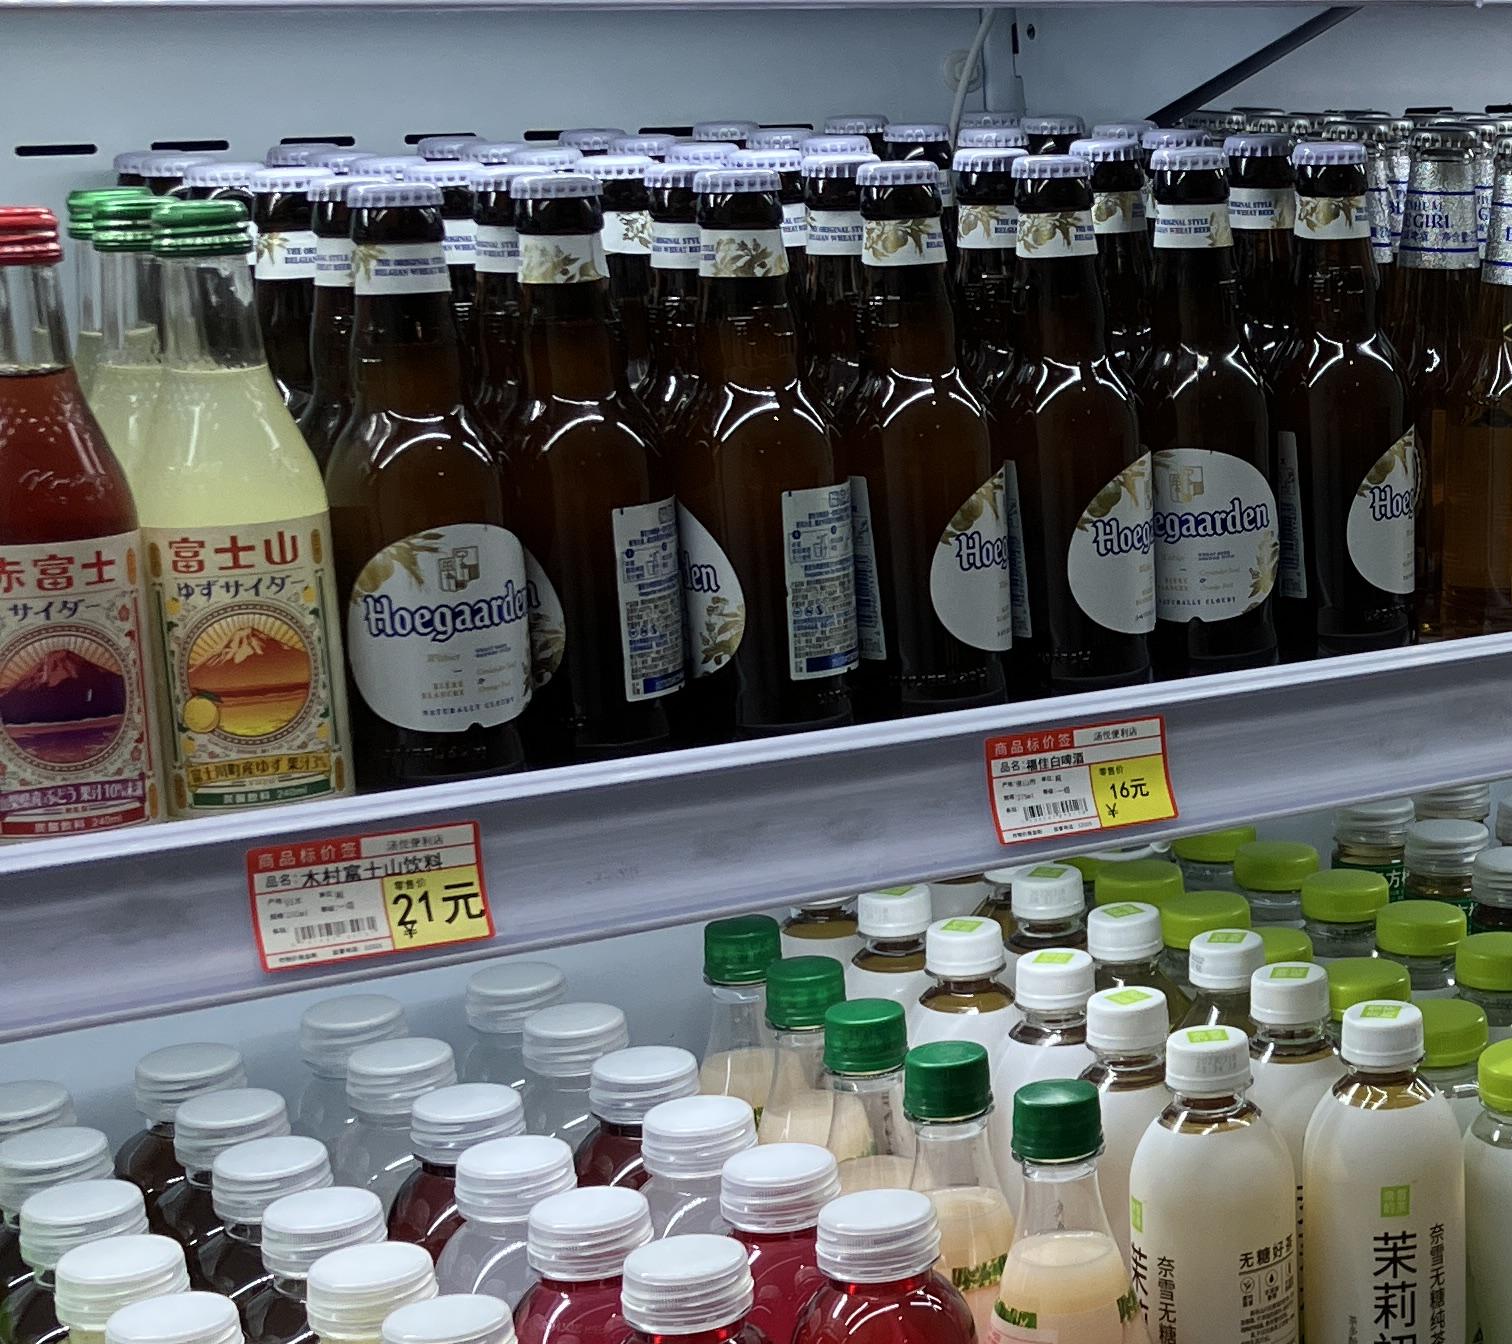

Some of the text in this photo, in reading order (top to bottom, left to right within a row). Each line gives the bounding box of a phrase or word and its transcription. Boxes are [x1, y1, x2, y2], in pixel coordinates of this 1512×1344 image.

[168, 530, 300, 574] 富士山
[176, 575, 305, 601] ゆずサイダー
[8, 598, 102, 622] サイダー
[362, 578, 541, 643] Hoegaarden
[995, 734, 1072, 755] 商品标价签
[1110, 778, 1150, 800] 16元
[258, 843, 358, 868] 商品标价签
[393, 882, 486, 927] 21元
